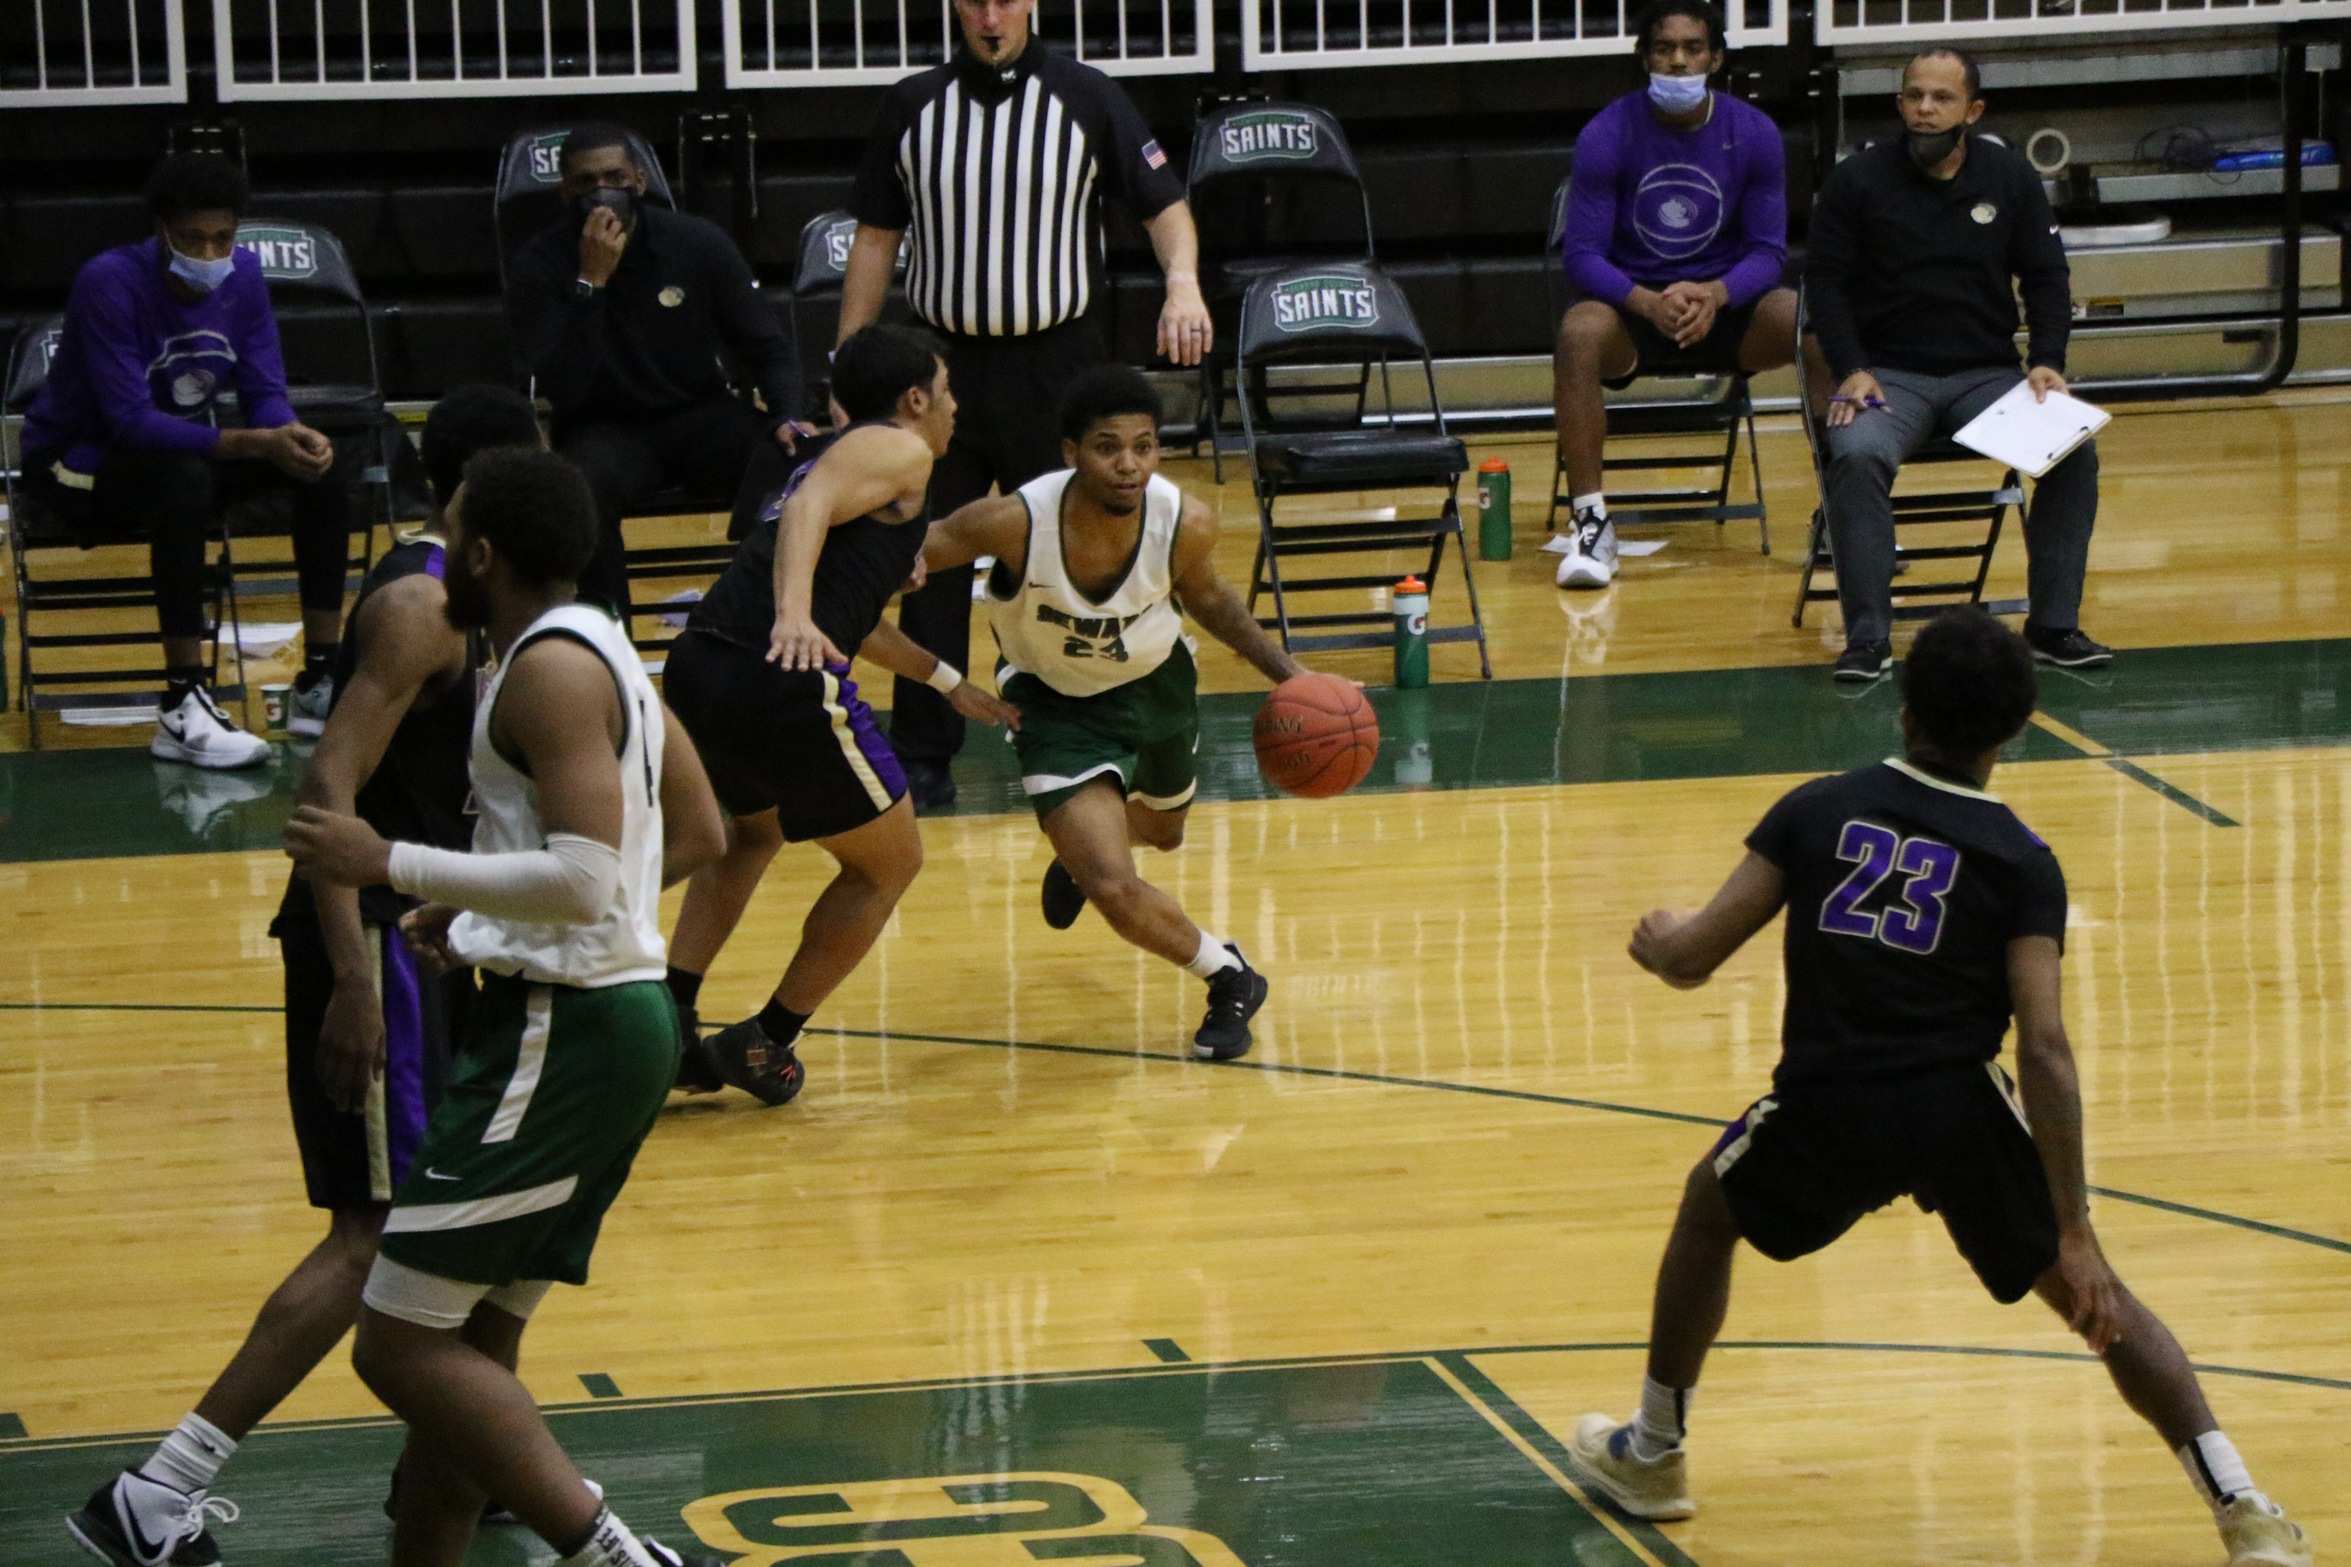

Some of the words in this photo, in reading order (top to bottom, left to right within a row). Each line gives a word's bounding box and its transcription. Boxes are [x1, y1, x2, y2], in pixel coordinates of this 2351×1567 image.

[1225, 123, 1312, 154] SAINTS
[1277, 289, 1372, 323] SAINTS
[1818, 820, 1961, 956] 23
